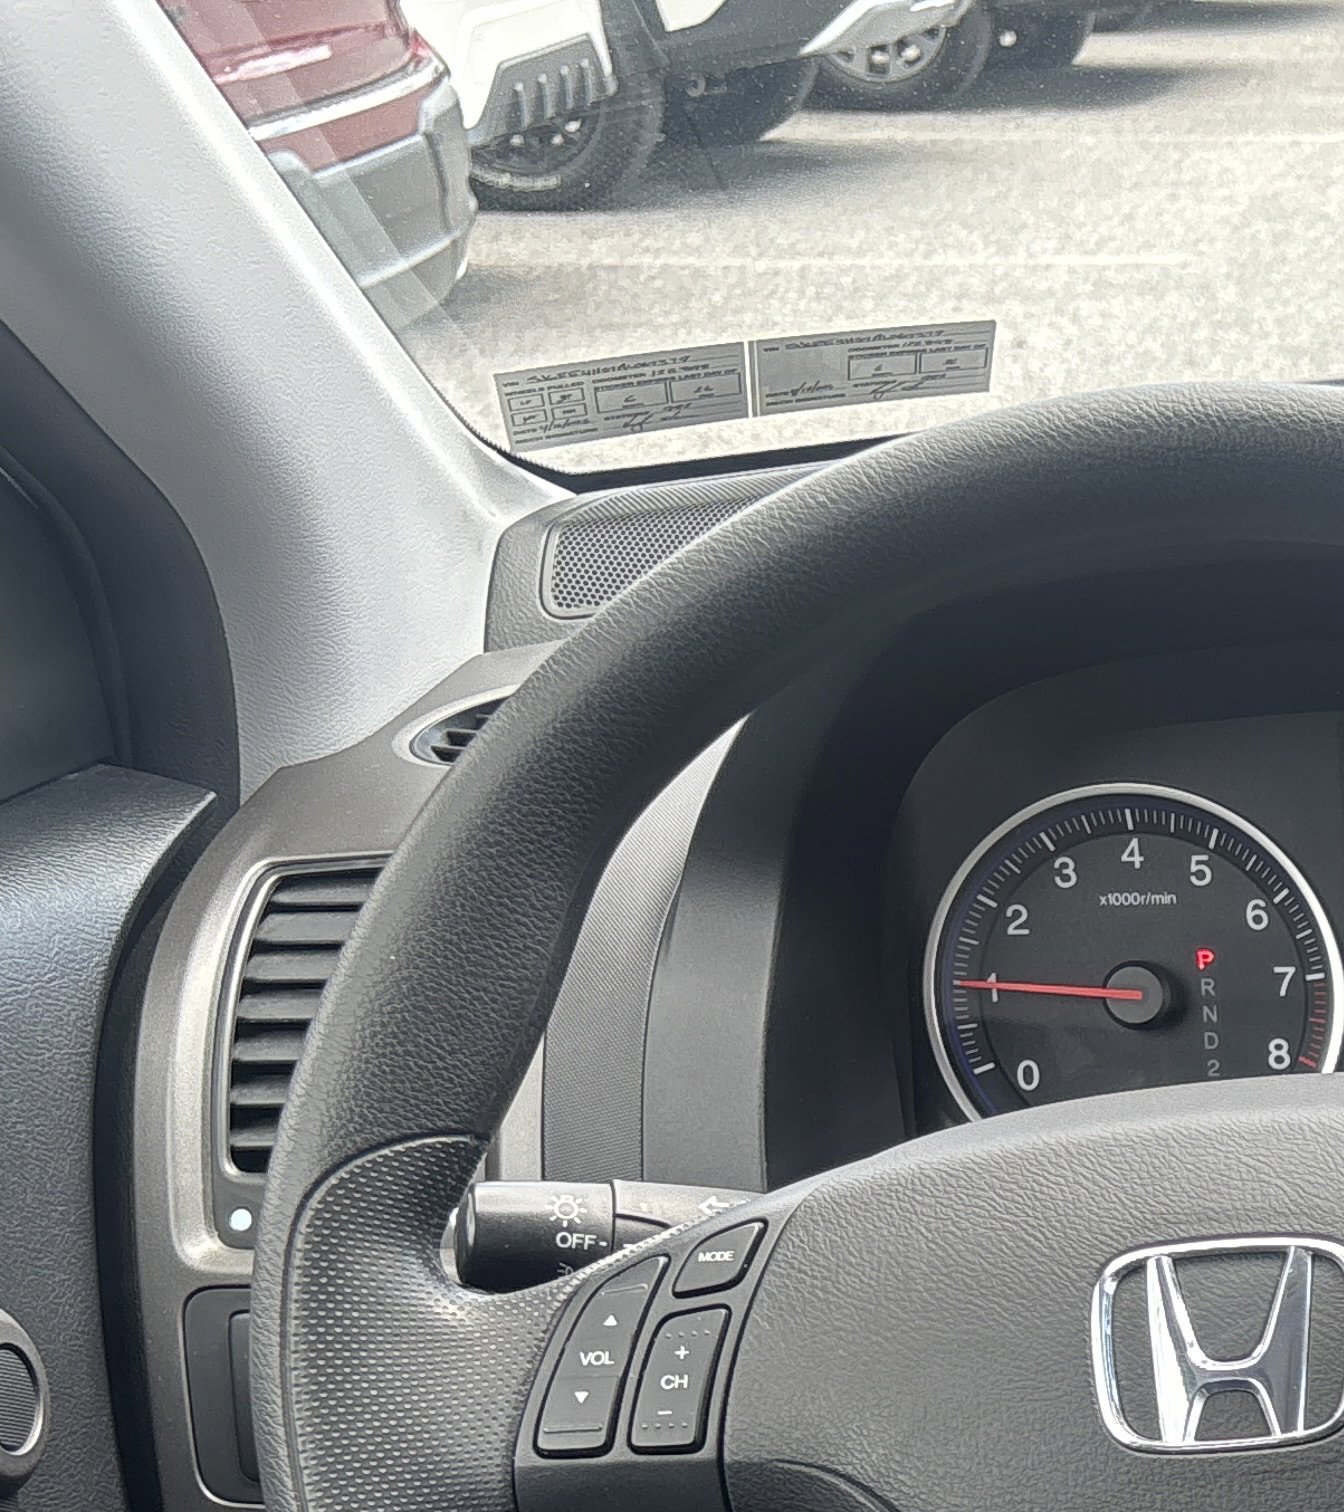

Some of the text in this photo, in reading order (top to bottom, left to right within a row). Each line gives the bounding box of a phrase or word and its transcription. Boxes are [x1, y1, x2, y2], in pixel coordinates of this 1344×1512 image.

[1121, 838, 1144, 868] 4
[1054, 857, 1077, 888] 3
[1190, 855, 1212, 886] 5
[1006, 905, 1030, 935] 2
[1246, 899, 1269, 930] 6
[1197, 950, 1215, 969] P
[987, 973, 998, 1003] 1
[1202, 978, 1215, 996] R
[1273, 967, 1296, 997] 7
[1203, 1005, 1217, 1023] N
[1204, 1032, 1219, 1050] D
[1268, 1039, 1291, 1069] 8
[1017, 1060, 1039, 1091] 0
[1207, 1059, 1221, 1077] 2
[556, 1232, 598, 1249] OFF
[698, 1251, 735, 1262] MODE
[579, 1351, 615, 1366] VOL
[660, 1375, 688, 1389] CH
